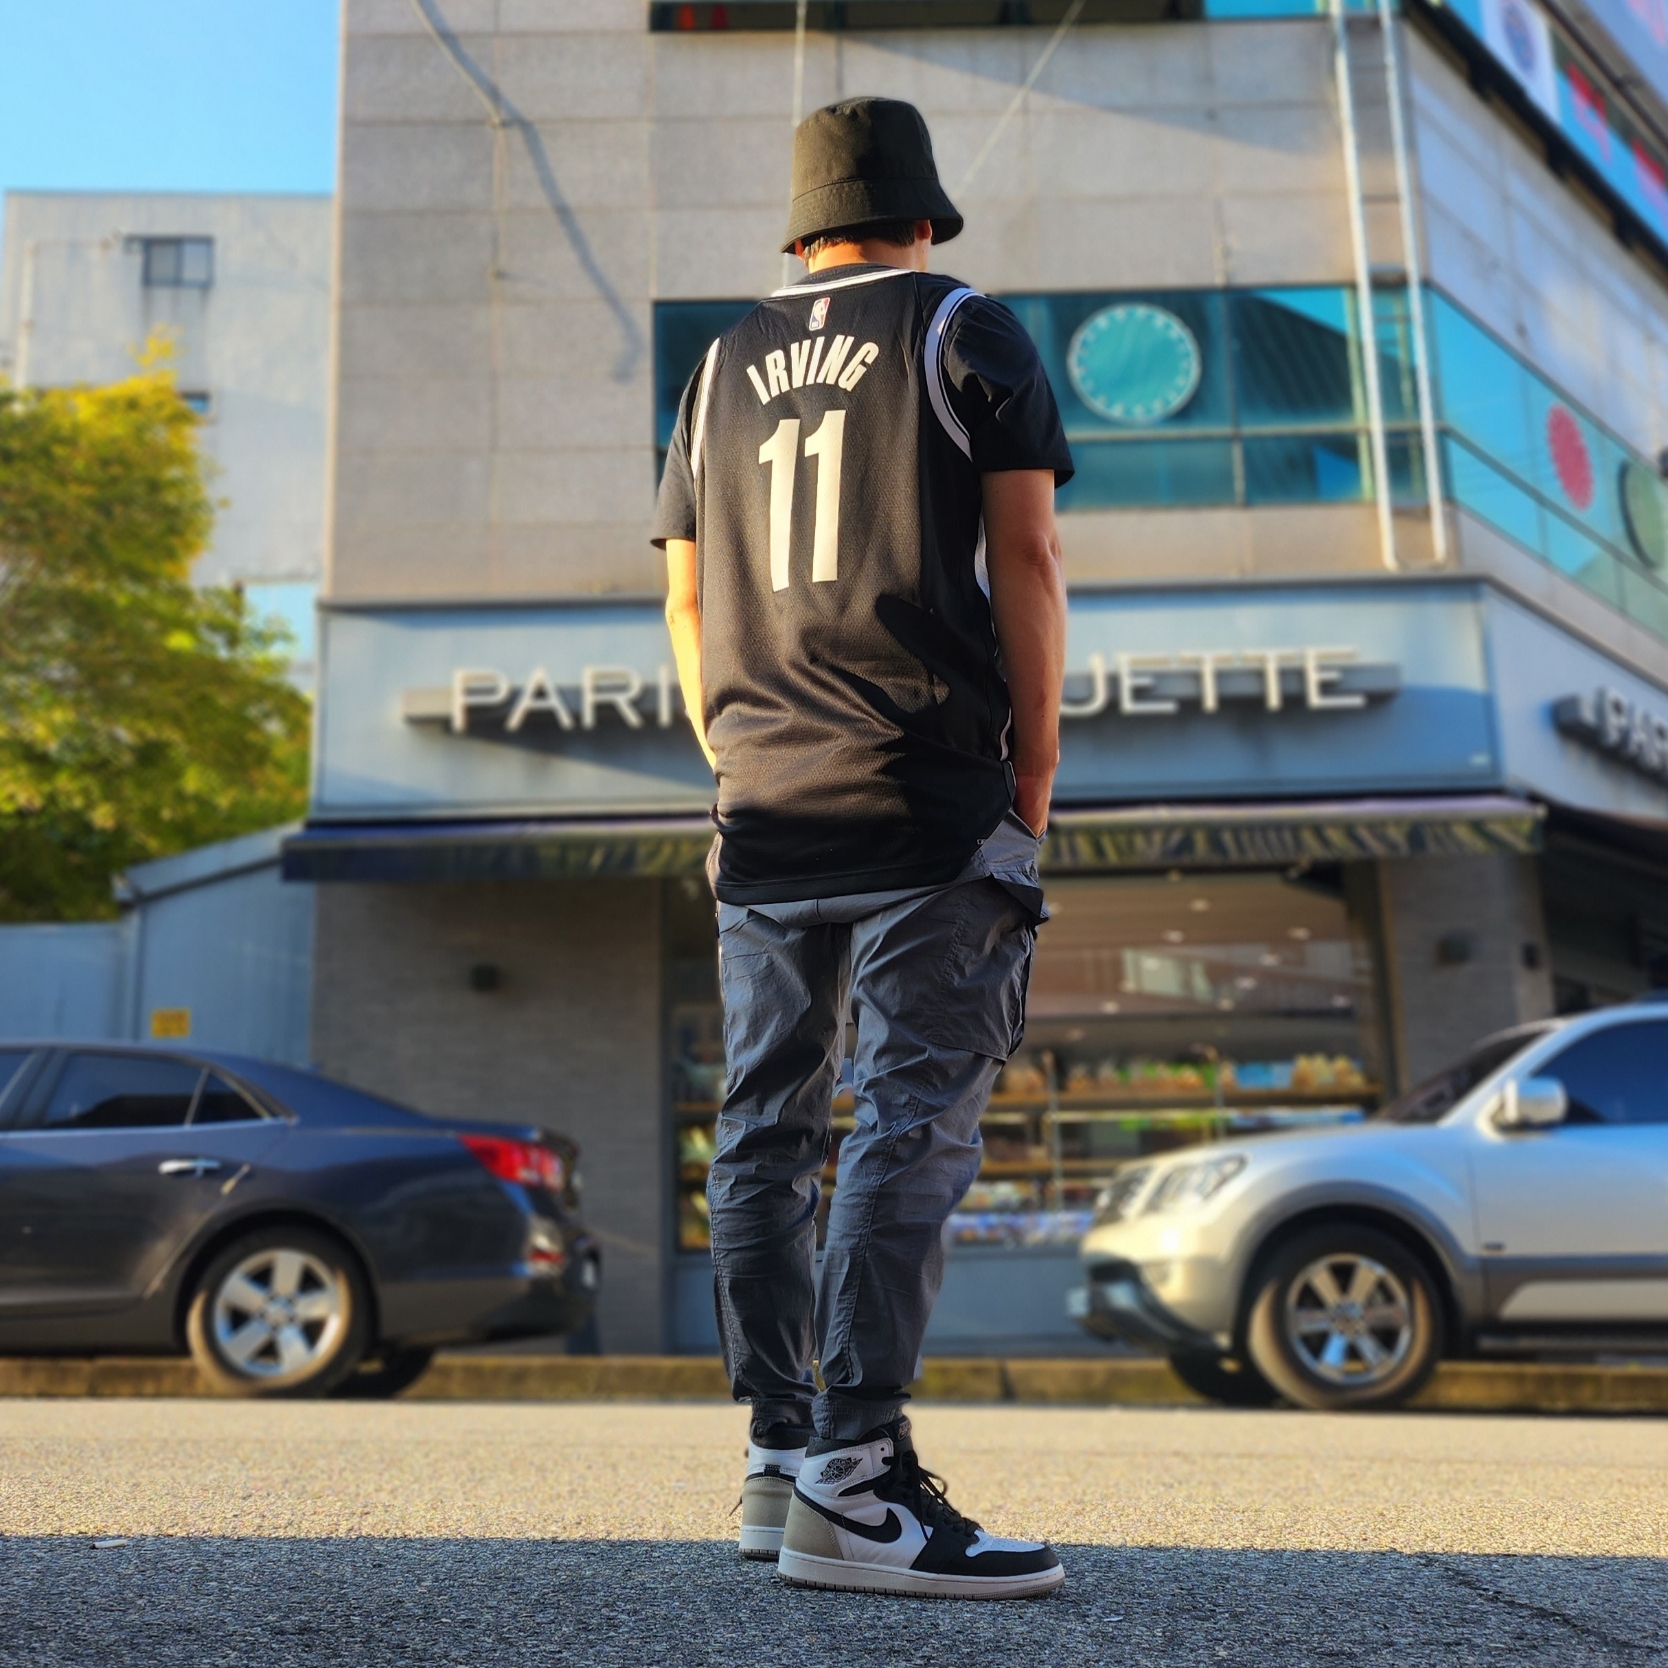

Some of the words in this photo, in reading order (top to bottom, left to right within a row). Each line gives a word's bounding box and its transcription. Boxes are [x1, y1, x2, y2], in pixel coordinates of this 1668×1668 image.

[746, 334, 880, 405] IRVING
[758, 409, 847, 592] 11
[453, 665, 690, 732] PARI
